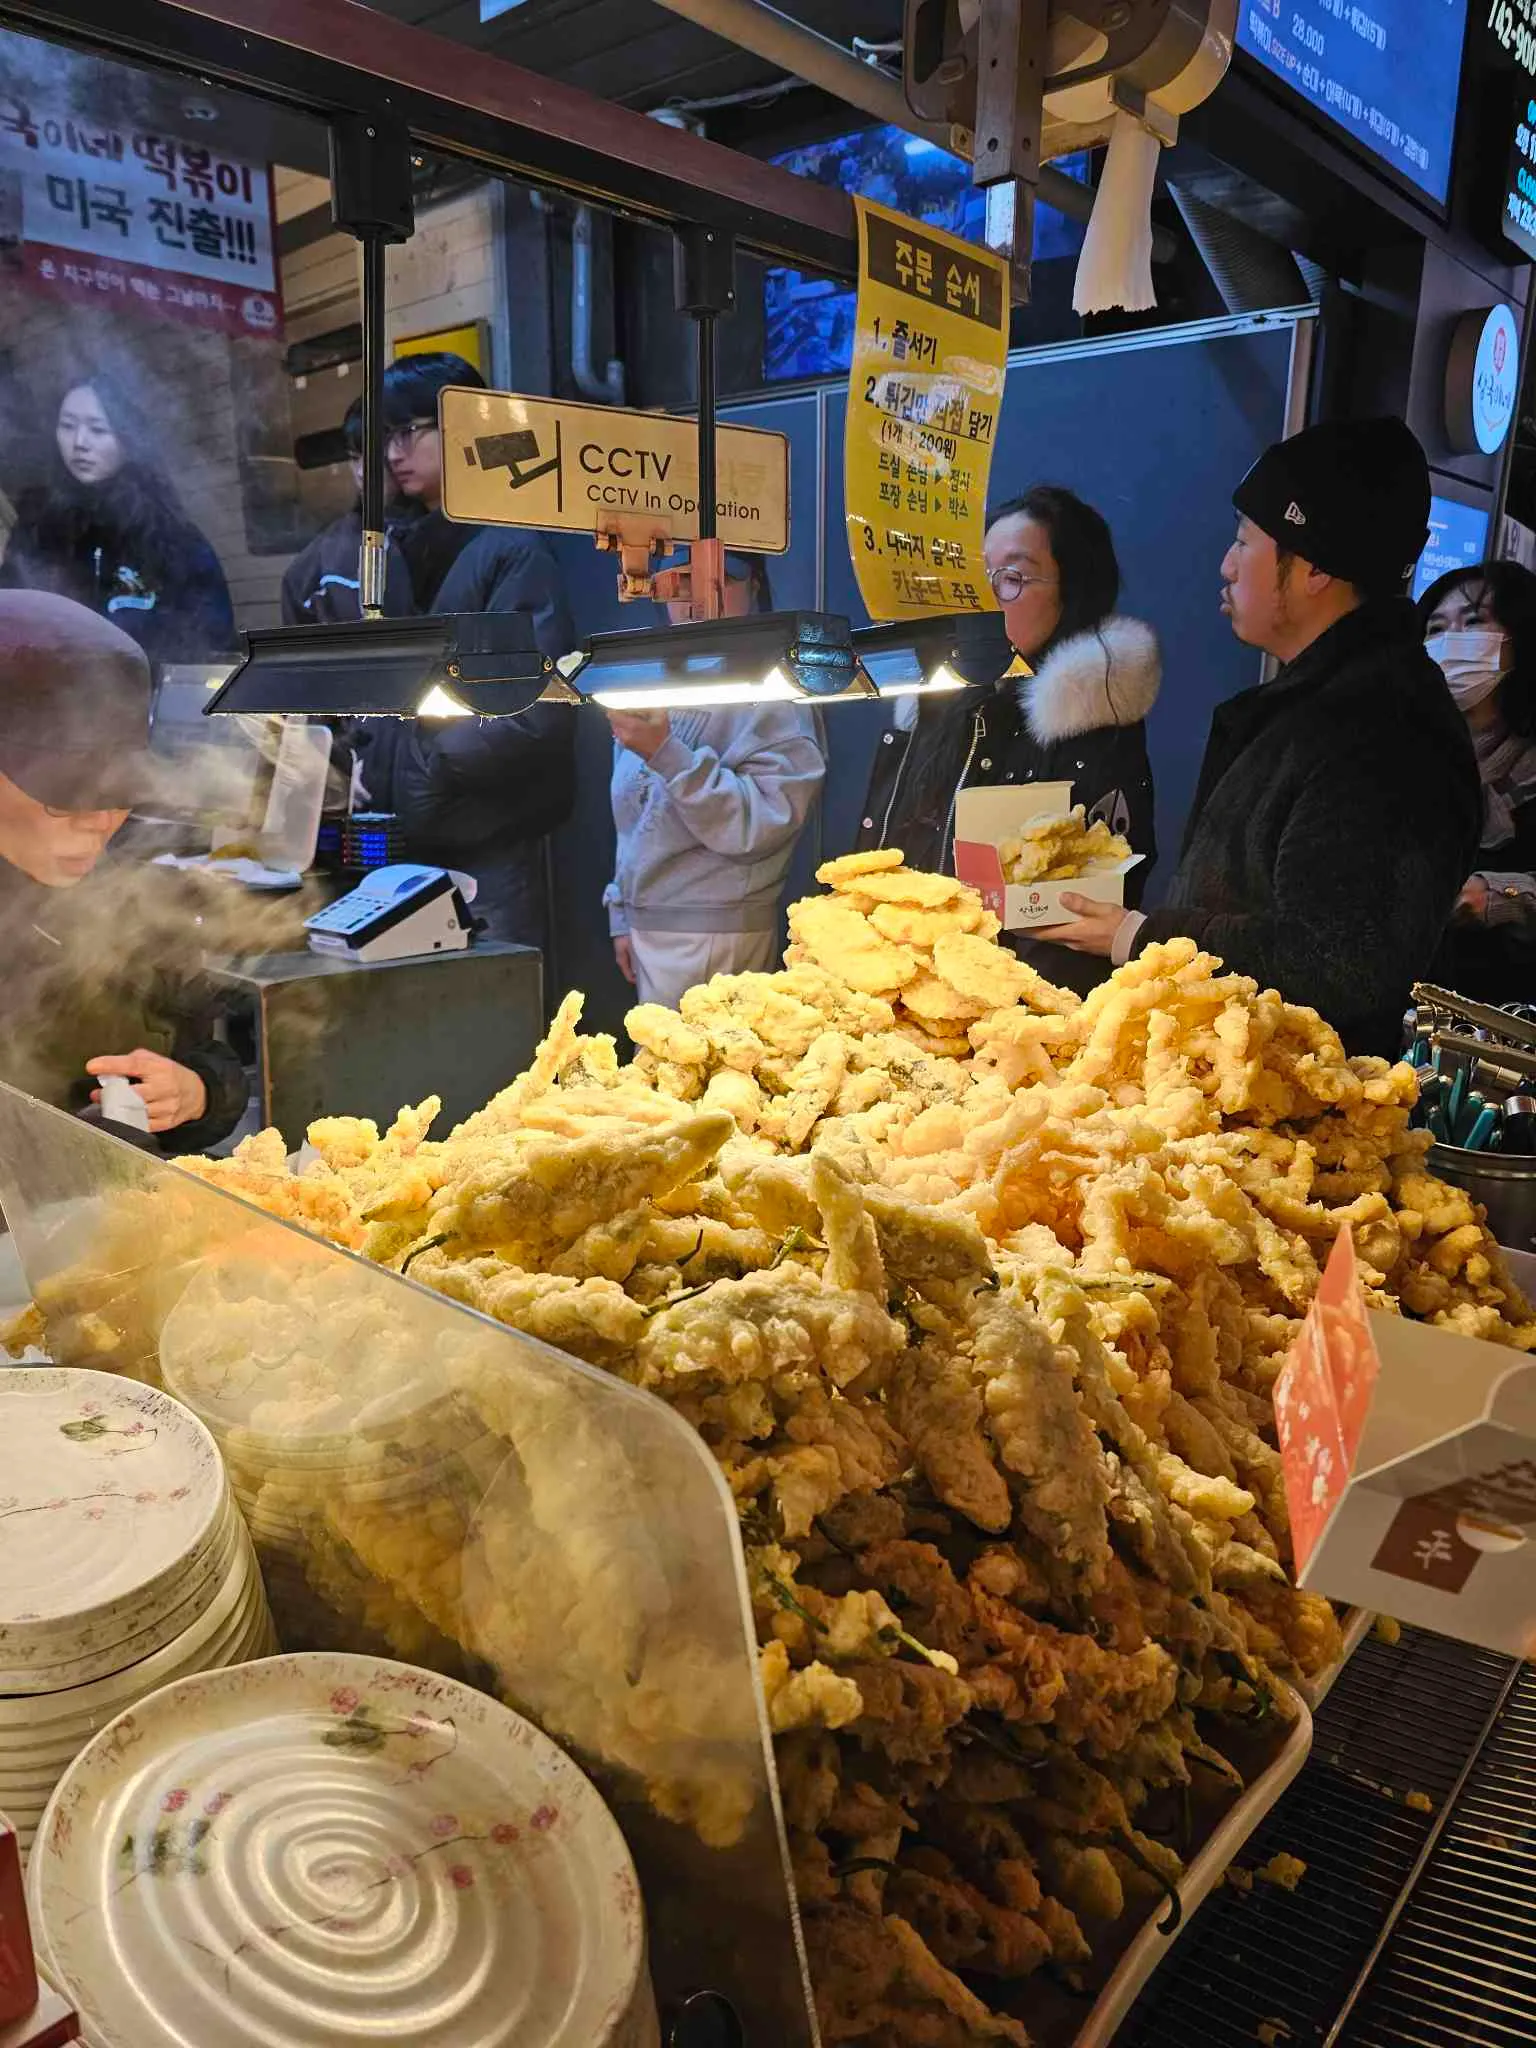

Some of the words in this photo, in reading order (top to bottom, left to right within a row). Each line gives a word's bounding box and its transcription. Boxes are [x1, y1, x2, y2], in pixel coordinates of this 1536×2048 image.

[131, 134, 253, 203] 떡볶이
[46, 173, 133, 237] 미국
[147, 196, 258, 265] 진출!!!
[895, 239, 933, 296] 주문
[946, 263, 980, 316] 순서
[892, 319, 938, 366] 줄서기
[864, 375, 879, 408] 2.
[968, 409, 993, 439] 담기
[579, 443, 672, 482] CCTV
[878, 452, 900, 479] 드실
[586, 484, 639, 506] CCTV
[645, 490, 661, 509] In
[668, 493, 760, 521] Opation
[879, 482, 901, 509] 포장
[907, 488, 928, 514] 손님
[948, 496, 969, 520] 박스
[863, 526, 882, 555] 3.
[886, 529, 925, 560] 나머지
[951, 582, 981, 608] 주문
